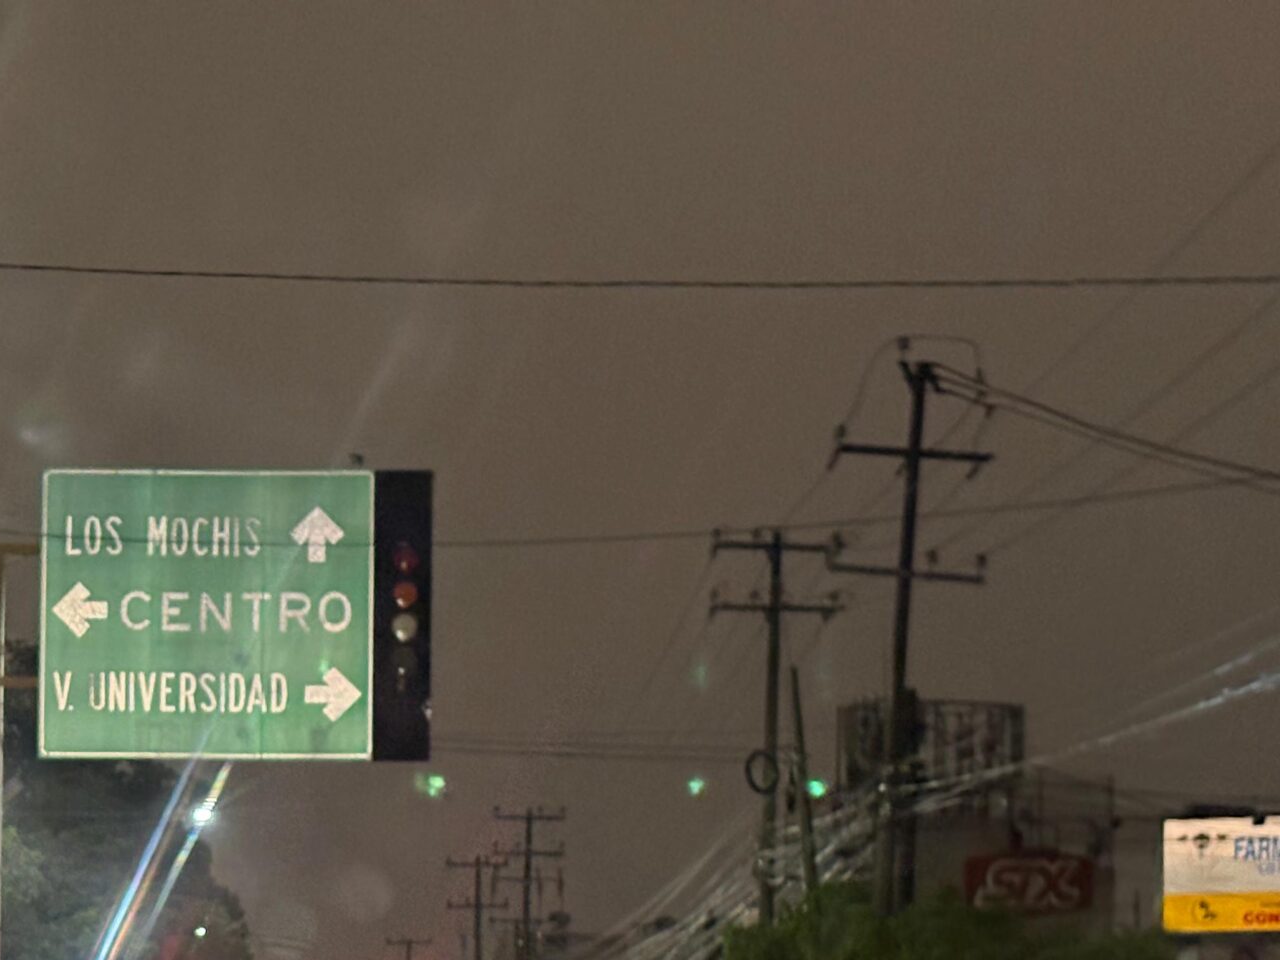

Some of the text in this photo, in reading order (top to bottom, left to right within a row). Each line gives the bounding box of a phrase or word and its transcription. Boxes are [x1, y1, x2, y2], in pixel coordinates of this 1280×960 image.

[65, 515, 262, 557] LOS MOCHIS
[120, 590, 353, 633] CENTRO
[52, 671, 289, 715] V. UNIVERSIDAD
